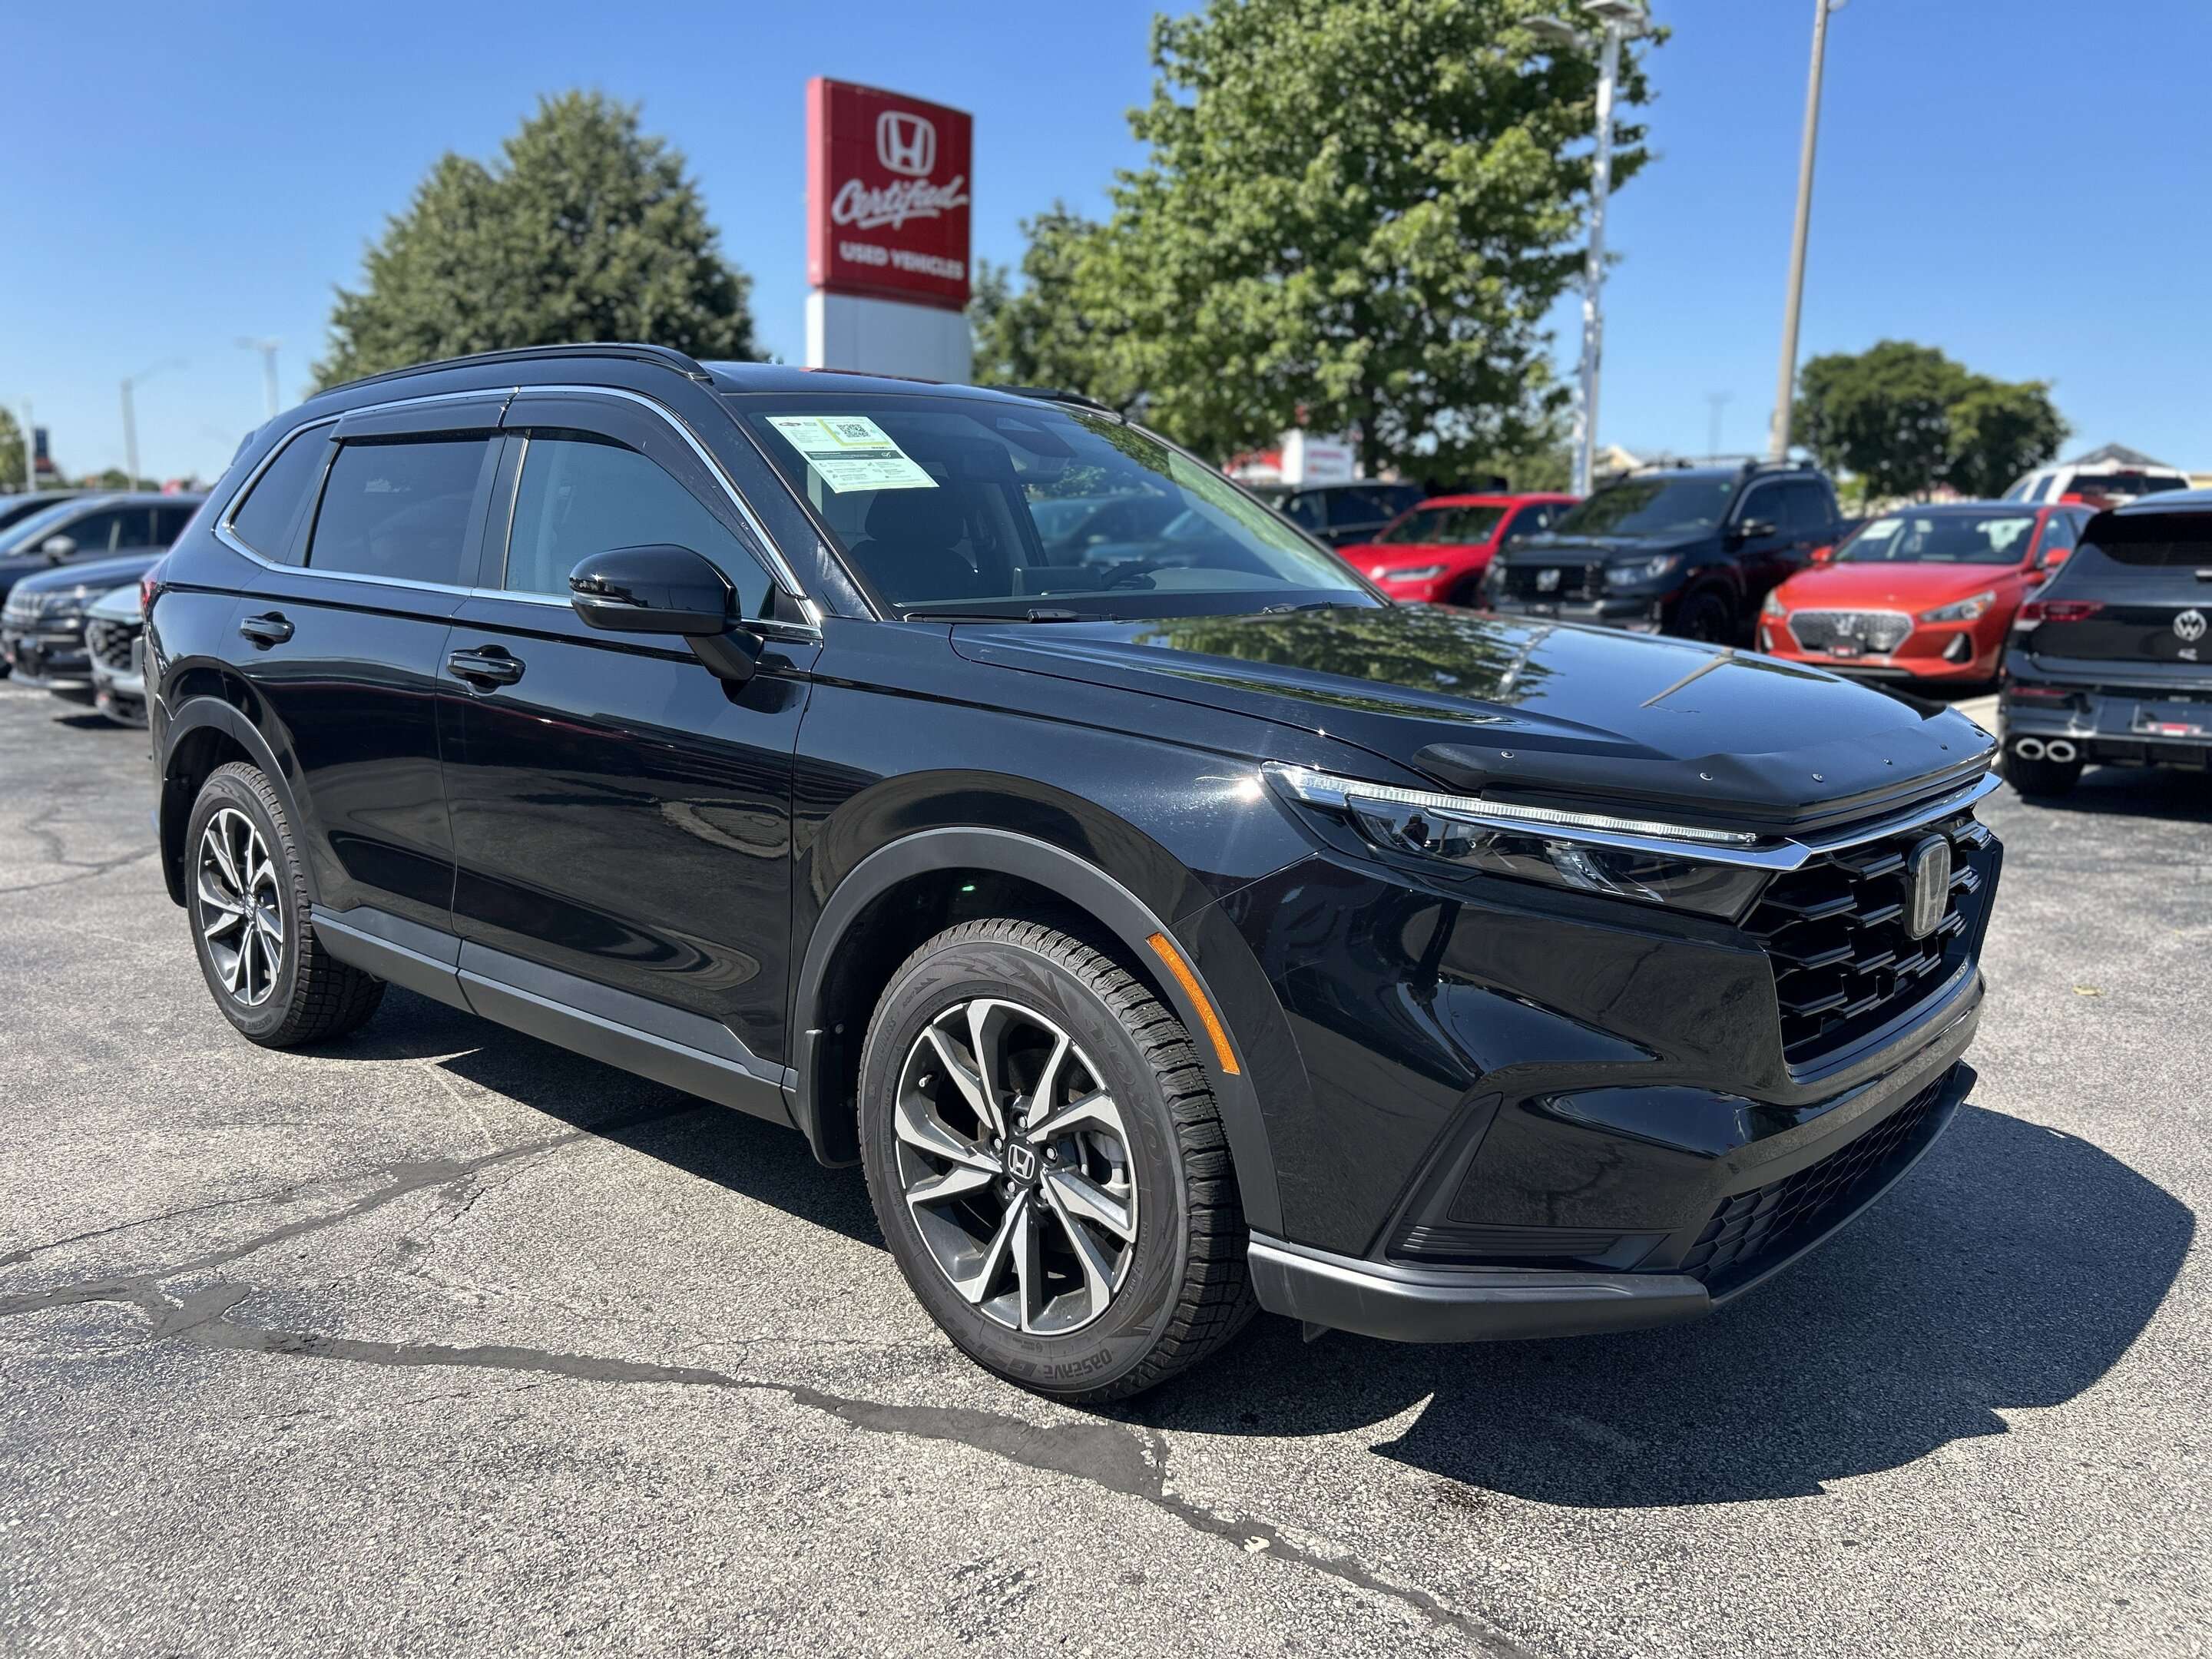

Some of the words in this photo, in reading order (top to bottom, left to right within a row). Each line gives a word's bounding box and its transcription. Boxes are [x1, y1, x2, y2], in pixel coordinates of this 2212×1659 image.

[832, 176, 969, 230] Certified
[839, 242, 889, 266] USED
[891, 250, 964, 279] VEHICLES
